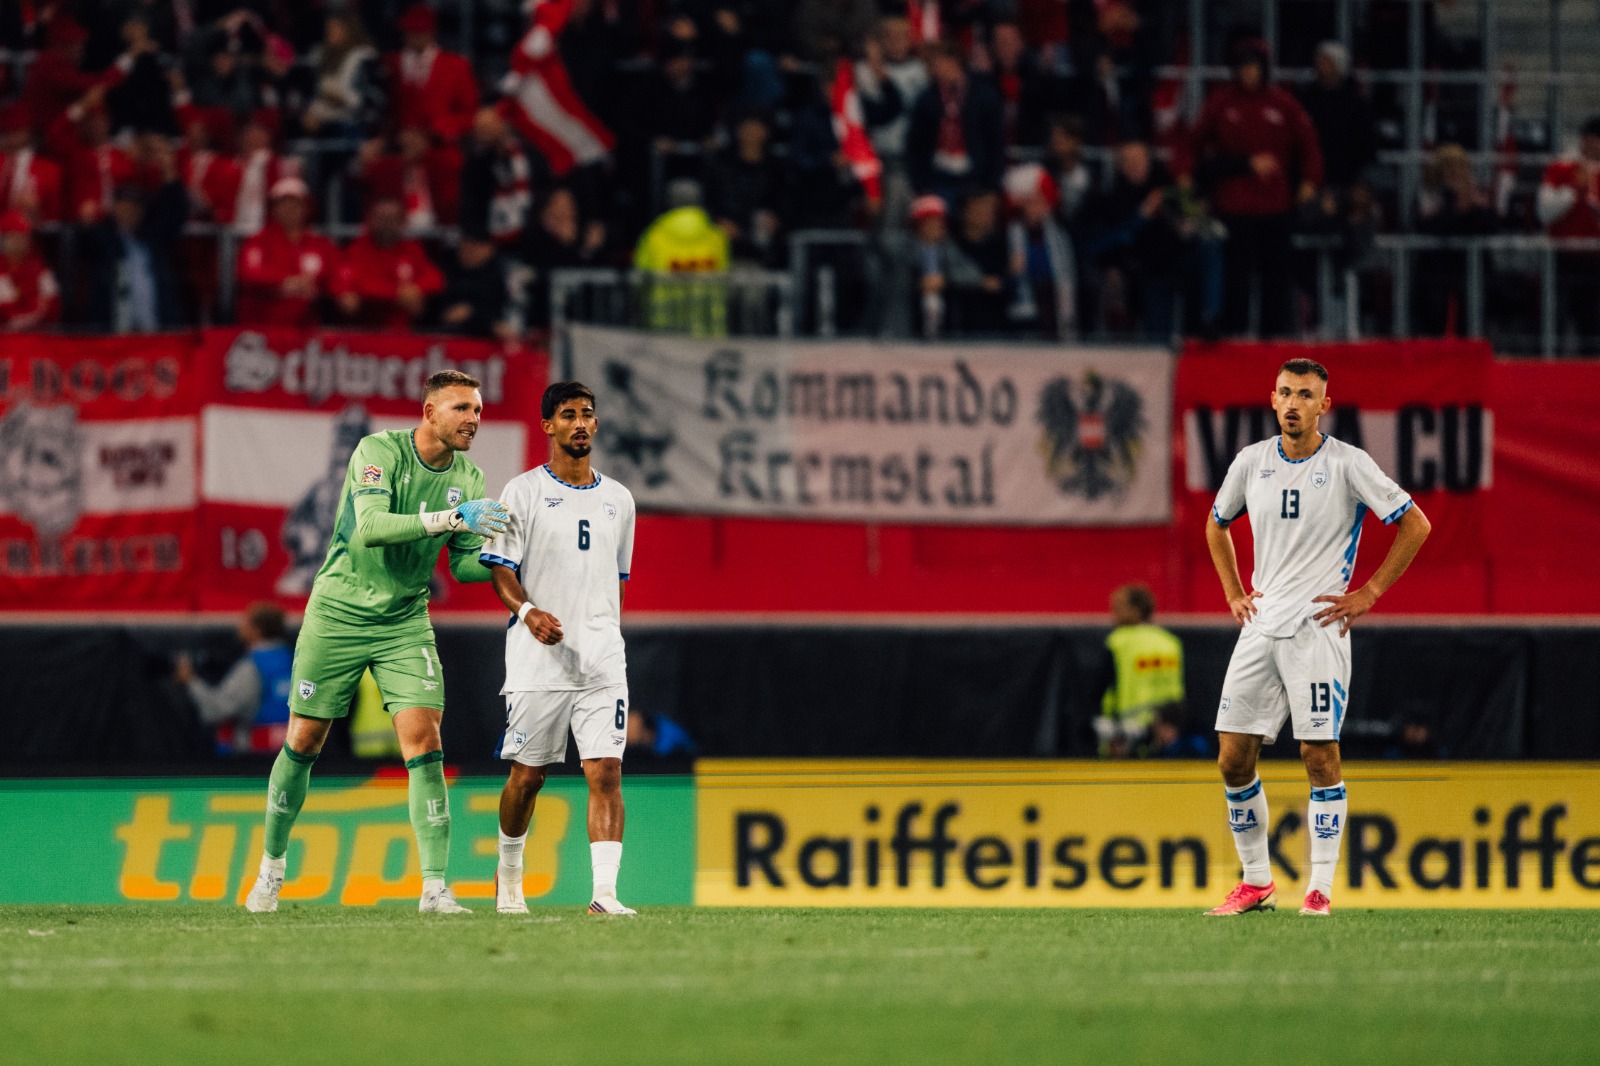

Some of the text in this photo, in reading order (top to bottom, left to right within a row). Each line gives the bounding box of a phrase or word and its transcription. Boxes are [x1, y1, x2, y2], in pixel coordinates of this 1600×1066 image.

[703, 350, 1018, 427] Kommando
[1195, 403, 1483, 493] VIA CU
[718, 430, 996, 507] Kremstal
[1281, 489, 1300, 519] 13
[578, 519, 590, 551] 6
[421, 647, 435, 677] 1
[1310, 682, 1330, 712] 13
[615, 698, 625, 730] 6
[267, 783, 287, 805] FA
[1230, 808, 1256, 822] IFA
[1315, 813, 1339, 828] IFA
[114, 785, 569, 906] tipp3
[735, 803, 1600, 889] Raiffeisen Raiffe
